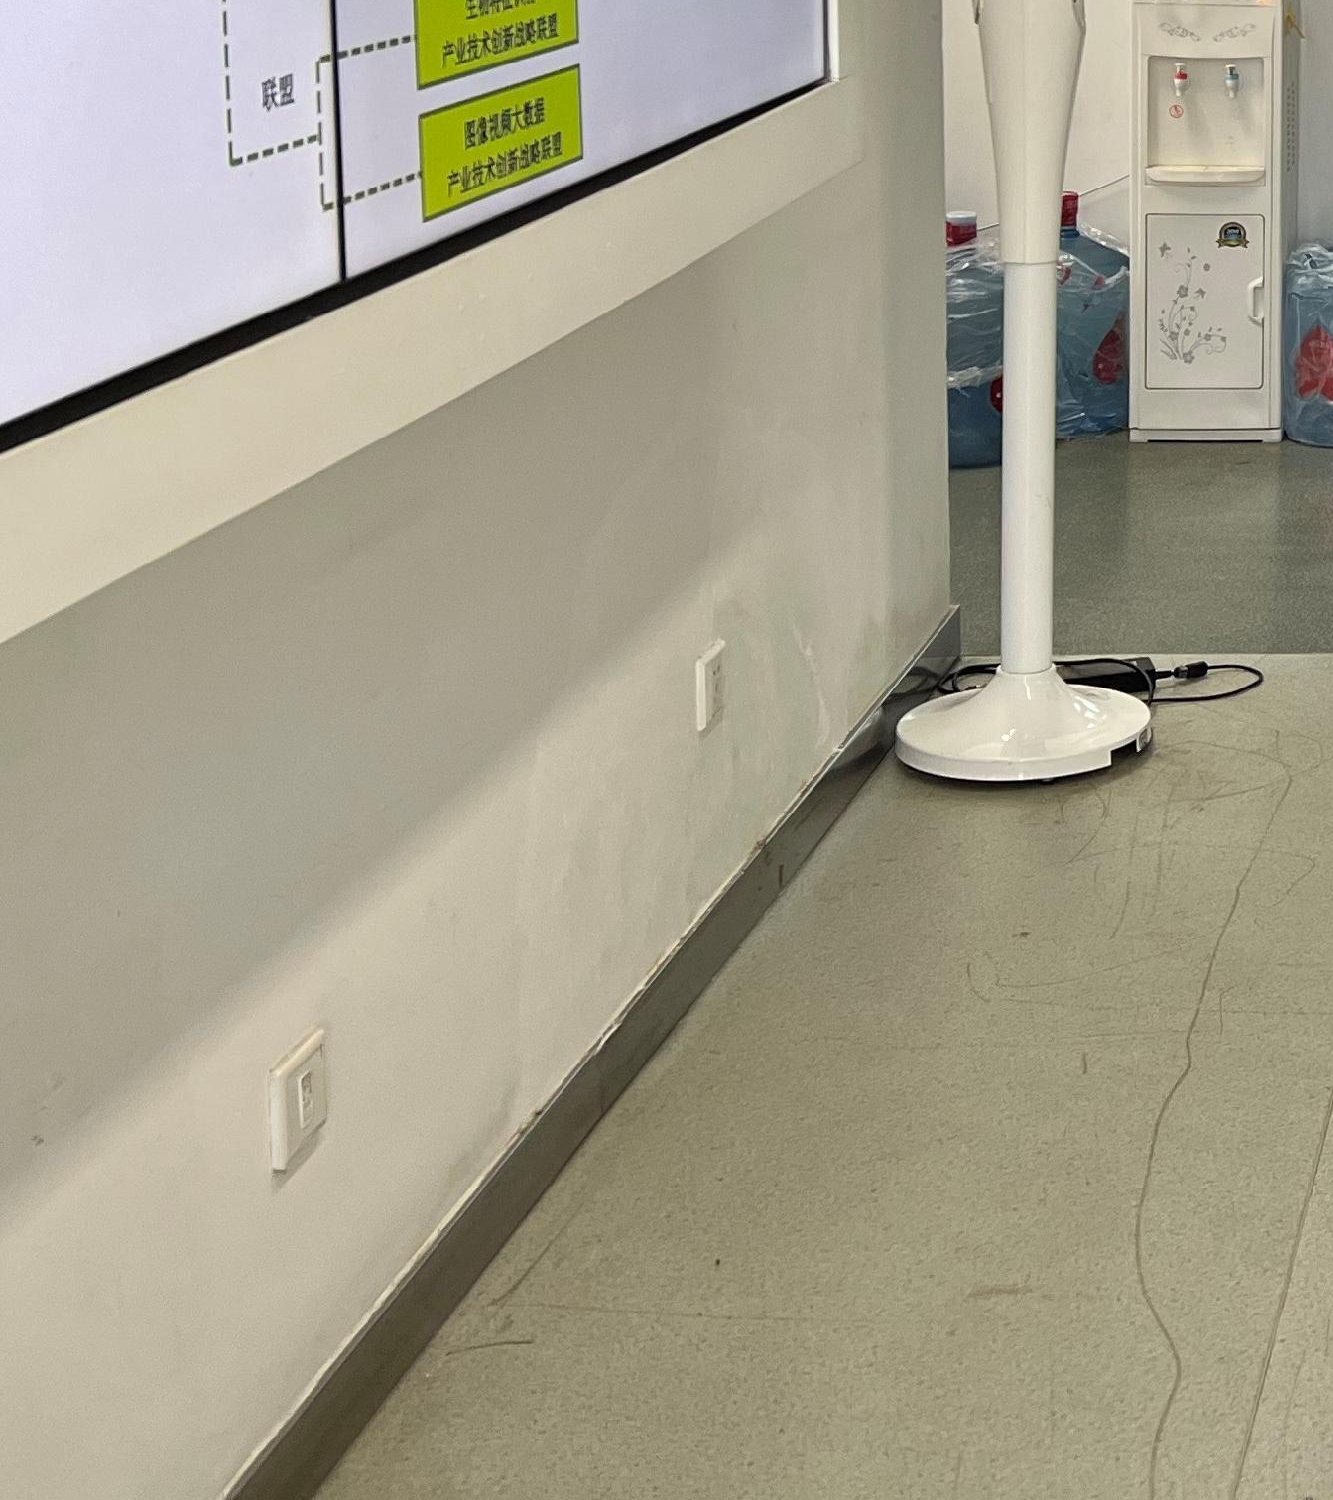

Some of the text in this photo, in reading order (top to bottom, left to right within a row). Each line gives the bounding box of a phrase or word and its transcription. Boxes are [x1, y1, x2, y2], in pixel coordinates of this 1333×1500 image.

[442, 13, 560, 68] 产业技术创新战略联盟
[262, 73, 295, 112] 联盟
[465, 97, 545, 150] 图像视频大数据
[447, 131, 563, 197] 产业技术创新战略联盟
